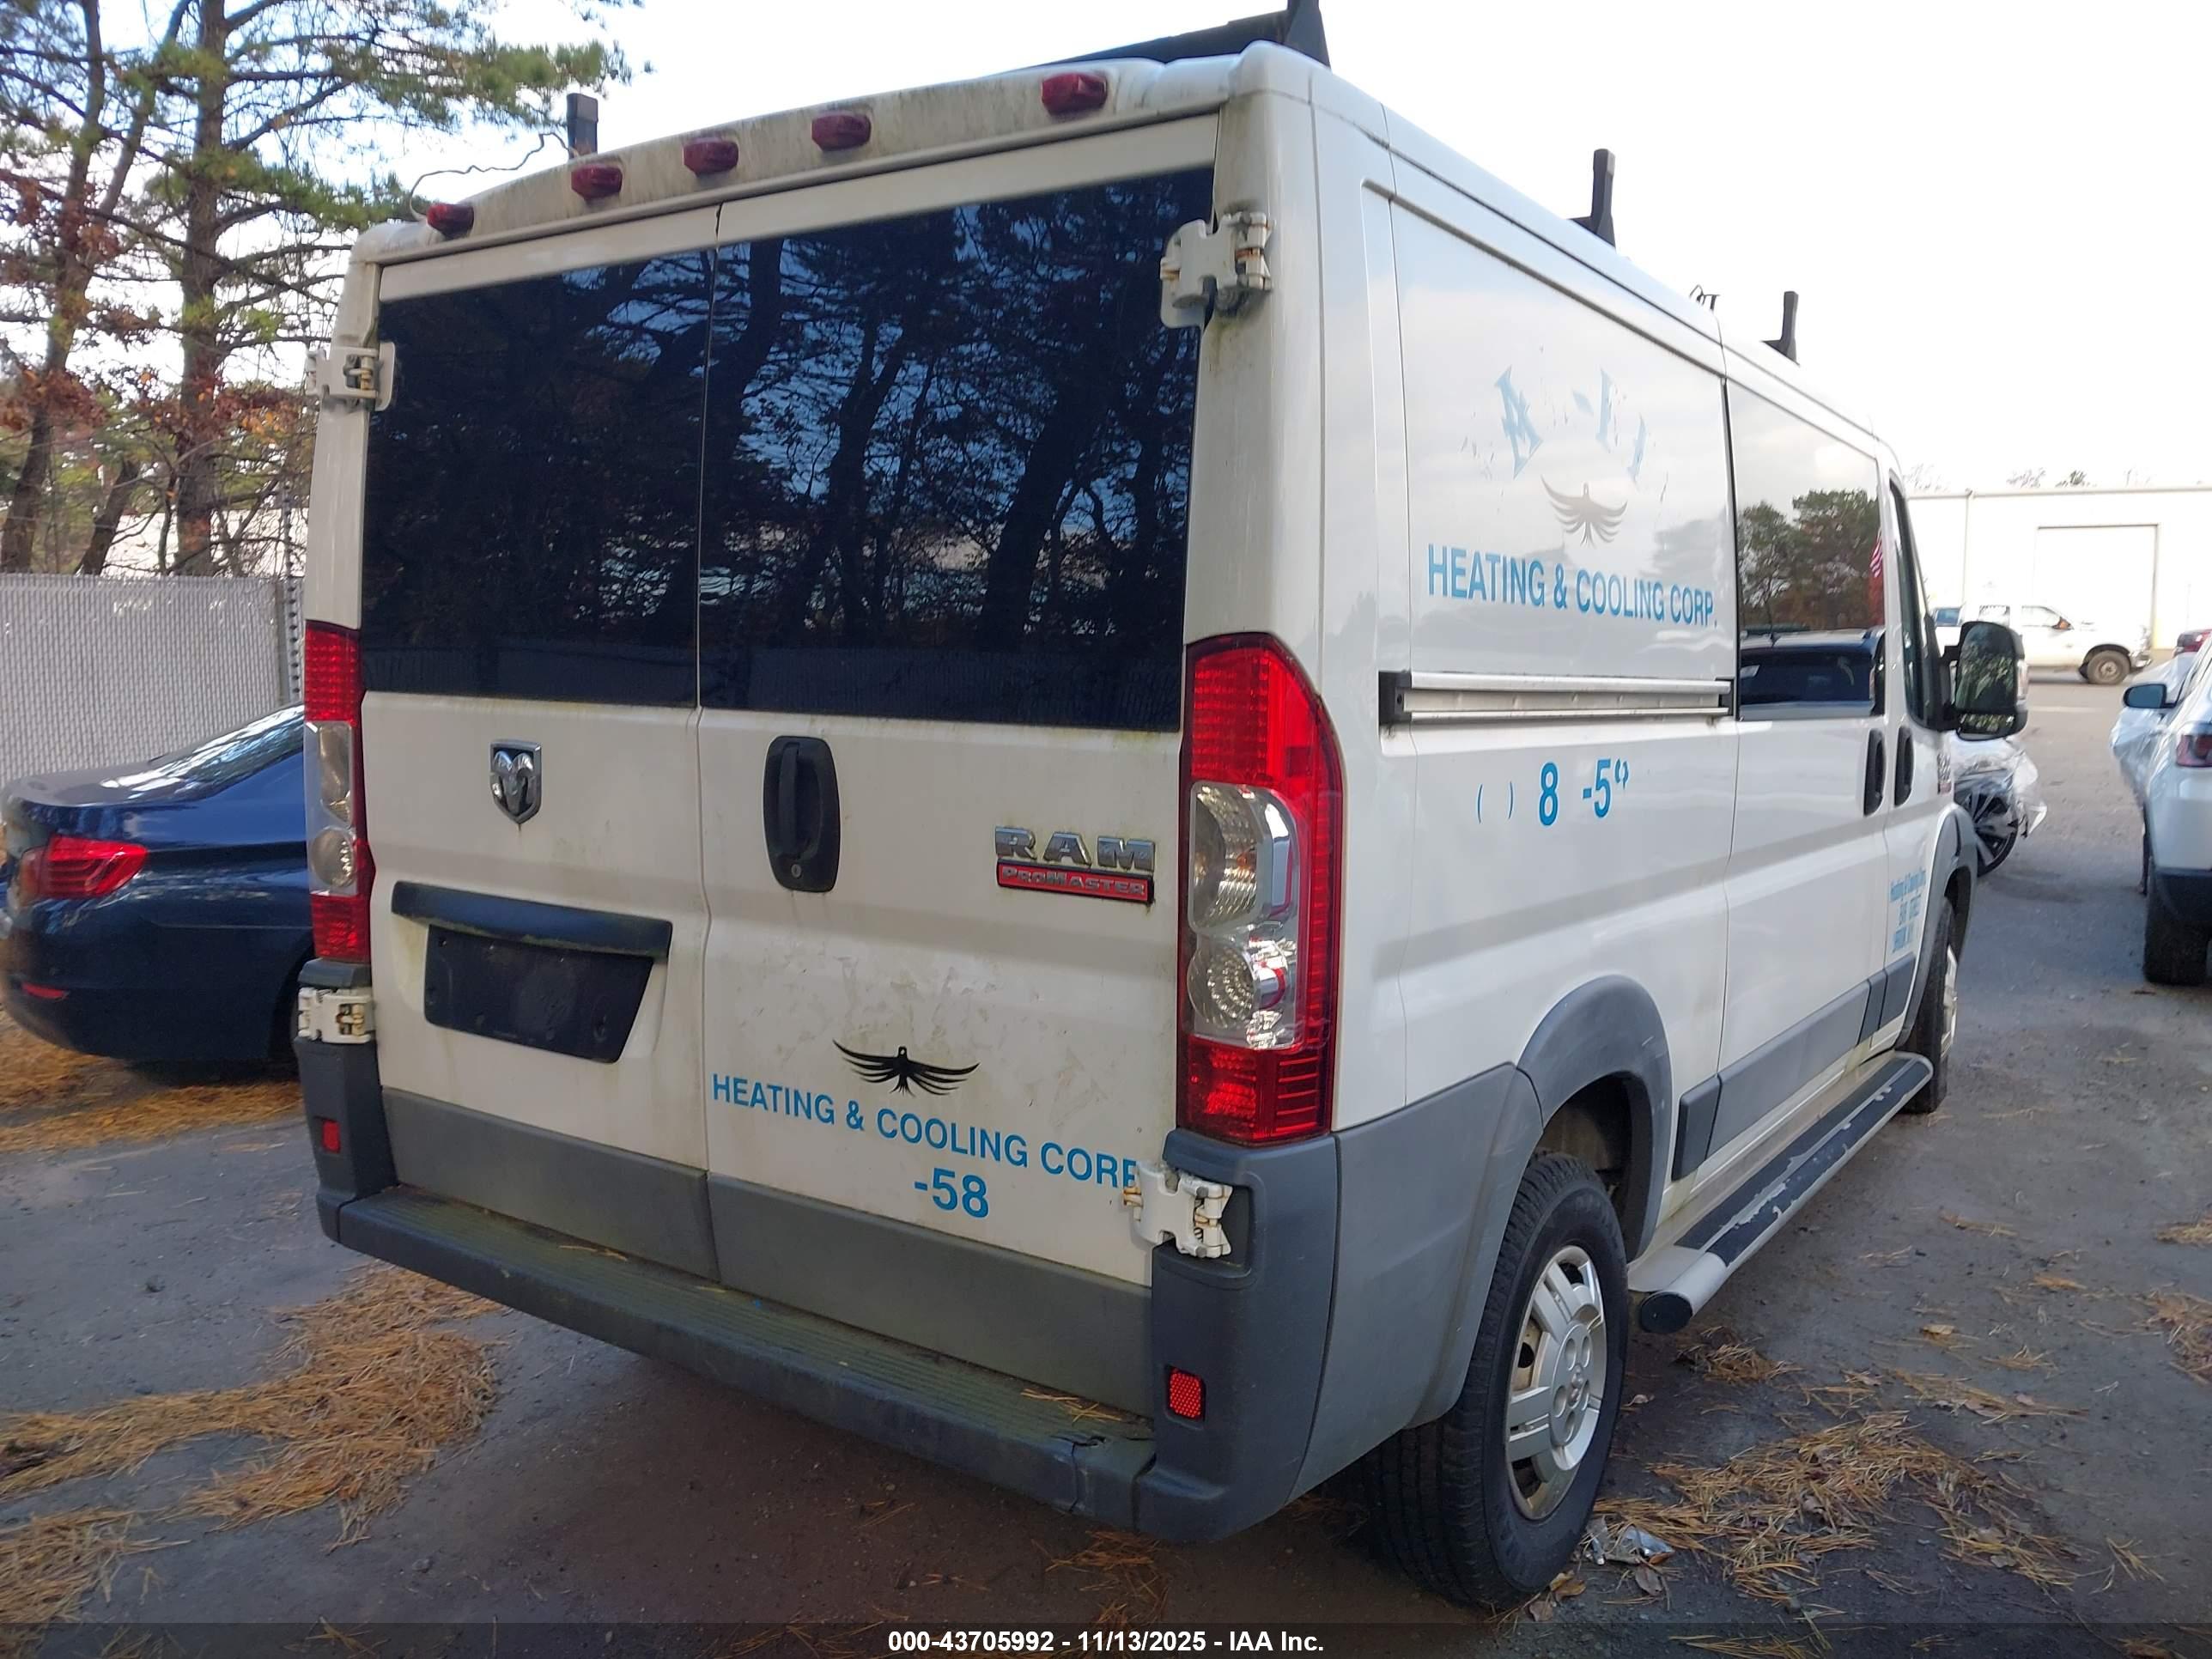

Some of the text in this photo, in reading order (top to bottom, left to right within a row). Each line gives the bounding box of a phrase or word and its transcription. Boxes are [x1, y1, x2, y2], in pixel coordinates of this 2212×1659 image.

[1427, 544, 1717, 628] HEATING & COOLING CORP.
[994, 826, 1156, 872] RAM
[712, 1073, 836, 1125] HEATING
[846, 1100, 865, 1132] &
[876, 1108, 1029, 1169] COOLING
[914, 1167, 990, 1219] -58
